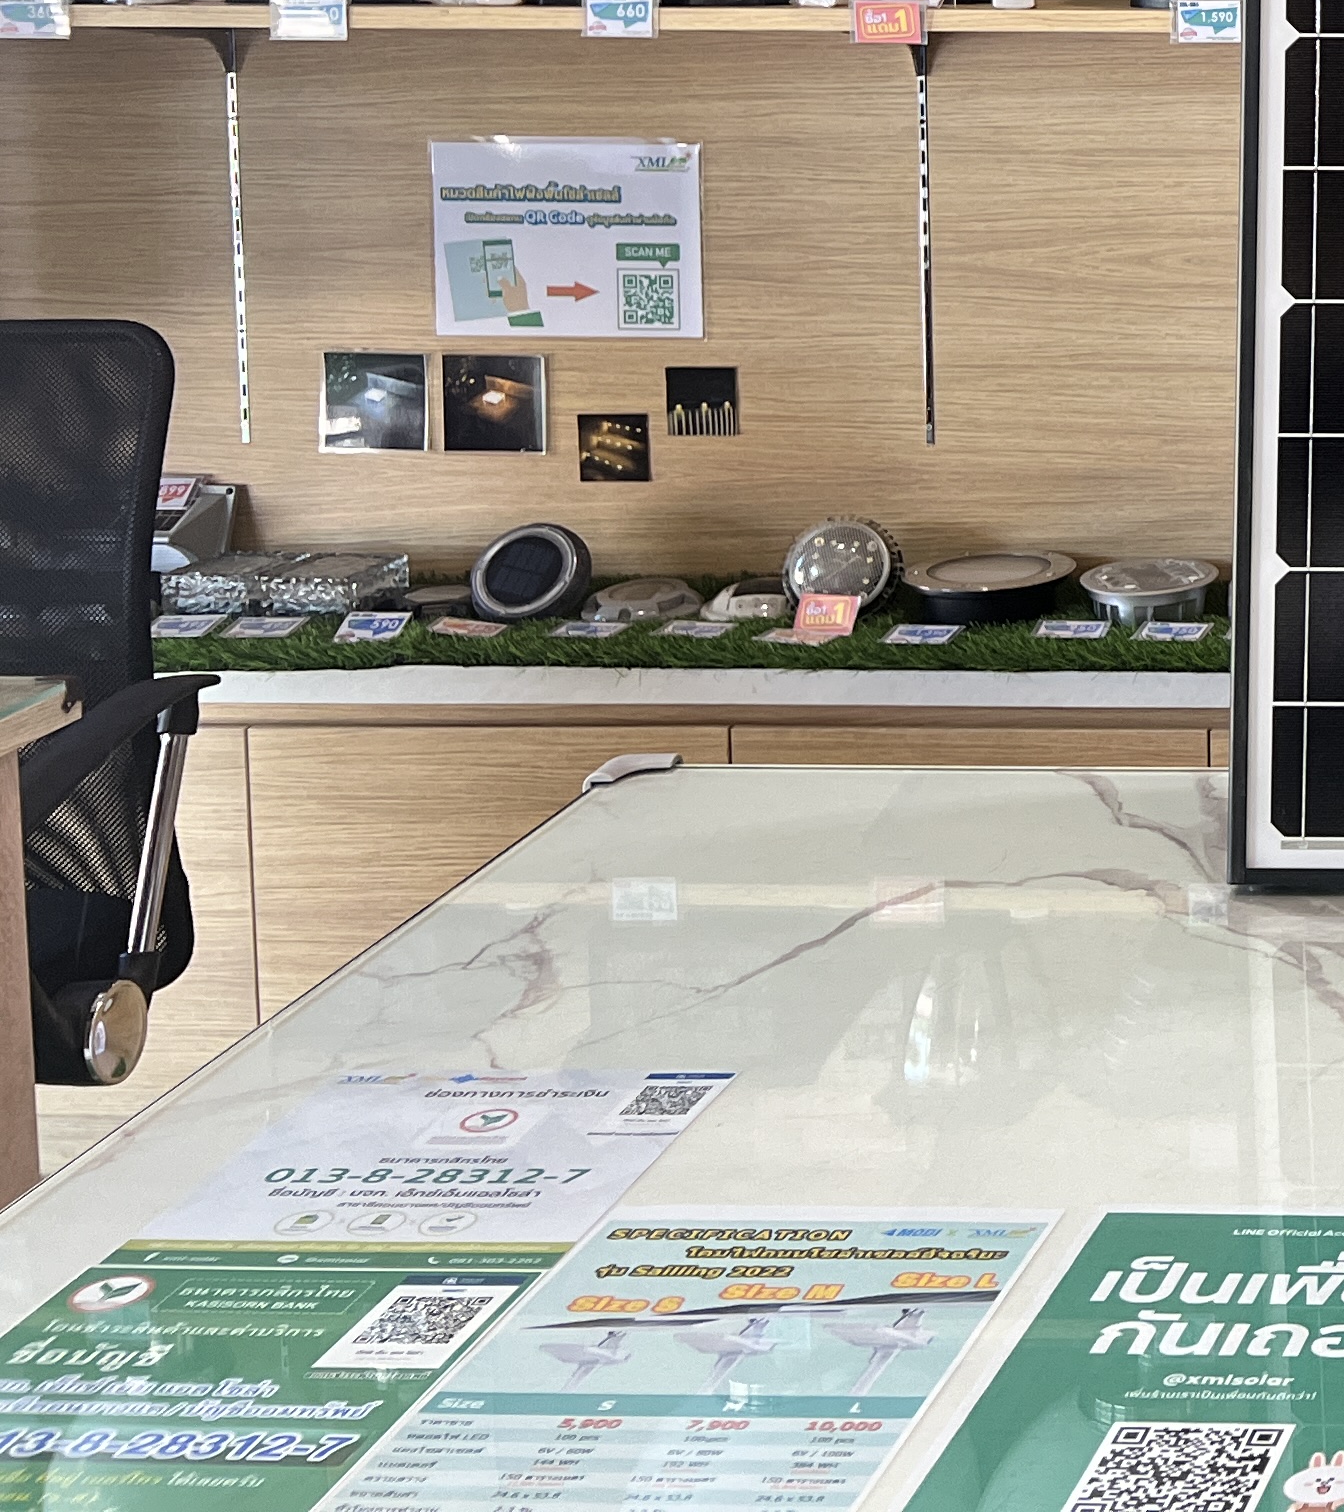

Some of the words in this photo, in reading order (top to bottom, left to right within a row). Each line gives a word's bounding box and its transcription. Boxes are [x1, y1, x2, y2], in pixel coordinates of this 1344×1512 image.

[616, 4, 645, 18] 660
[1200, 10, 1234, 25] 1,590
[636, 155, 668, 169] XML
[524, 211, 547, 225] QR
[549, 211, 585, 225] Code
[624, 246, 652, 258] SCAN
[654, 246, 672, 258] ME
[370, 619, 400, 630] 590
[264, 1166, 591, 1186] 013-8-28312-7
[606, 1228, 853, 1242] SPECIFICATION
[1232, 1227, 1264, 1237] LINE
[1267, 1227, 1322, 1238] Official
[732, 1264, 796, 1279] 2022
[891, 1272, 971, 1289] Size
[973, 1273, 1000, 1289] L
[719, 1284, 800, 1301] Size
[802, 1283, 845, 1301] M
[271, 1300, 319, 1310] BANK
[567, 1296, 646, 1314] Size
[652, 1296, 685, 1314] S
[4, 1336, 174, 1369] ชื่อบัญชี
[1162, 1371, 1296, 1389] @xmlsolar
[437, 1396, 485, 1411] Size
[597, 1400, 618, 1412] S
[556, 1418, 624, 1431] 5,900
[685, 1419, 750, 1432] 7,900
[803, 1419, 883, 1432] 10,000
